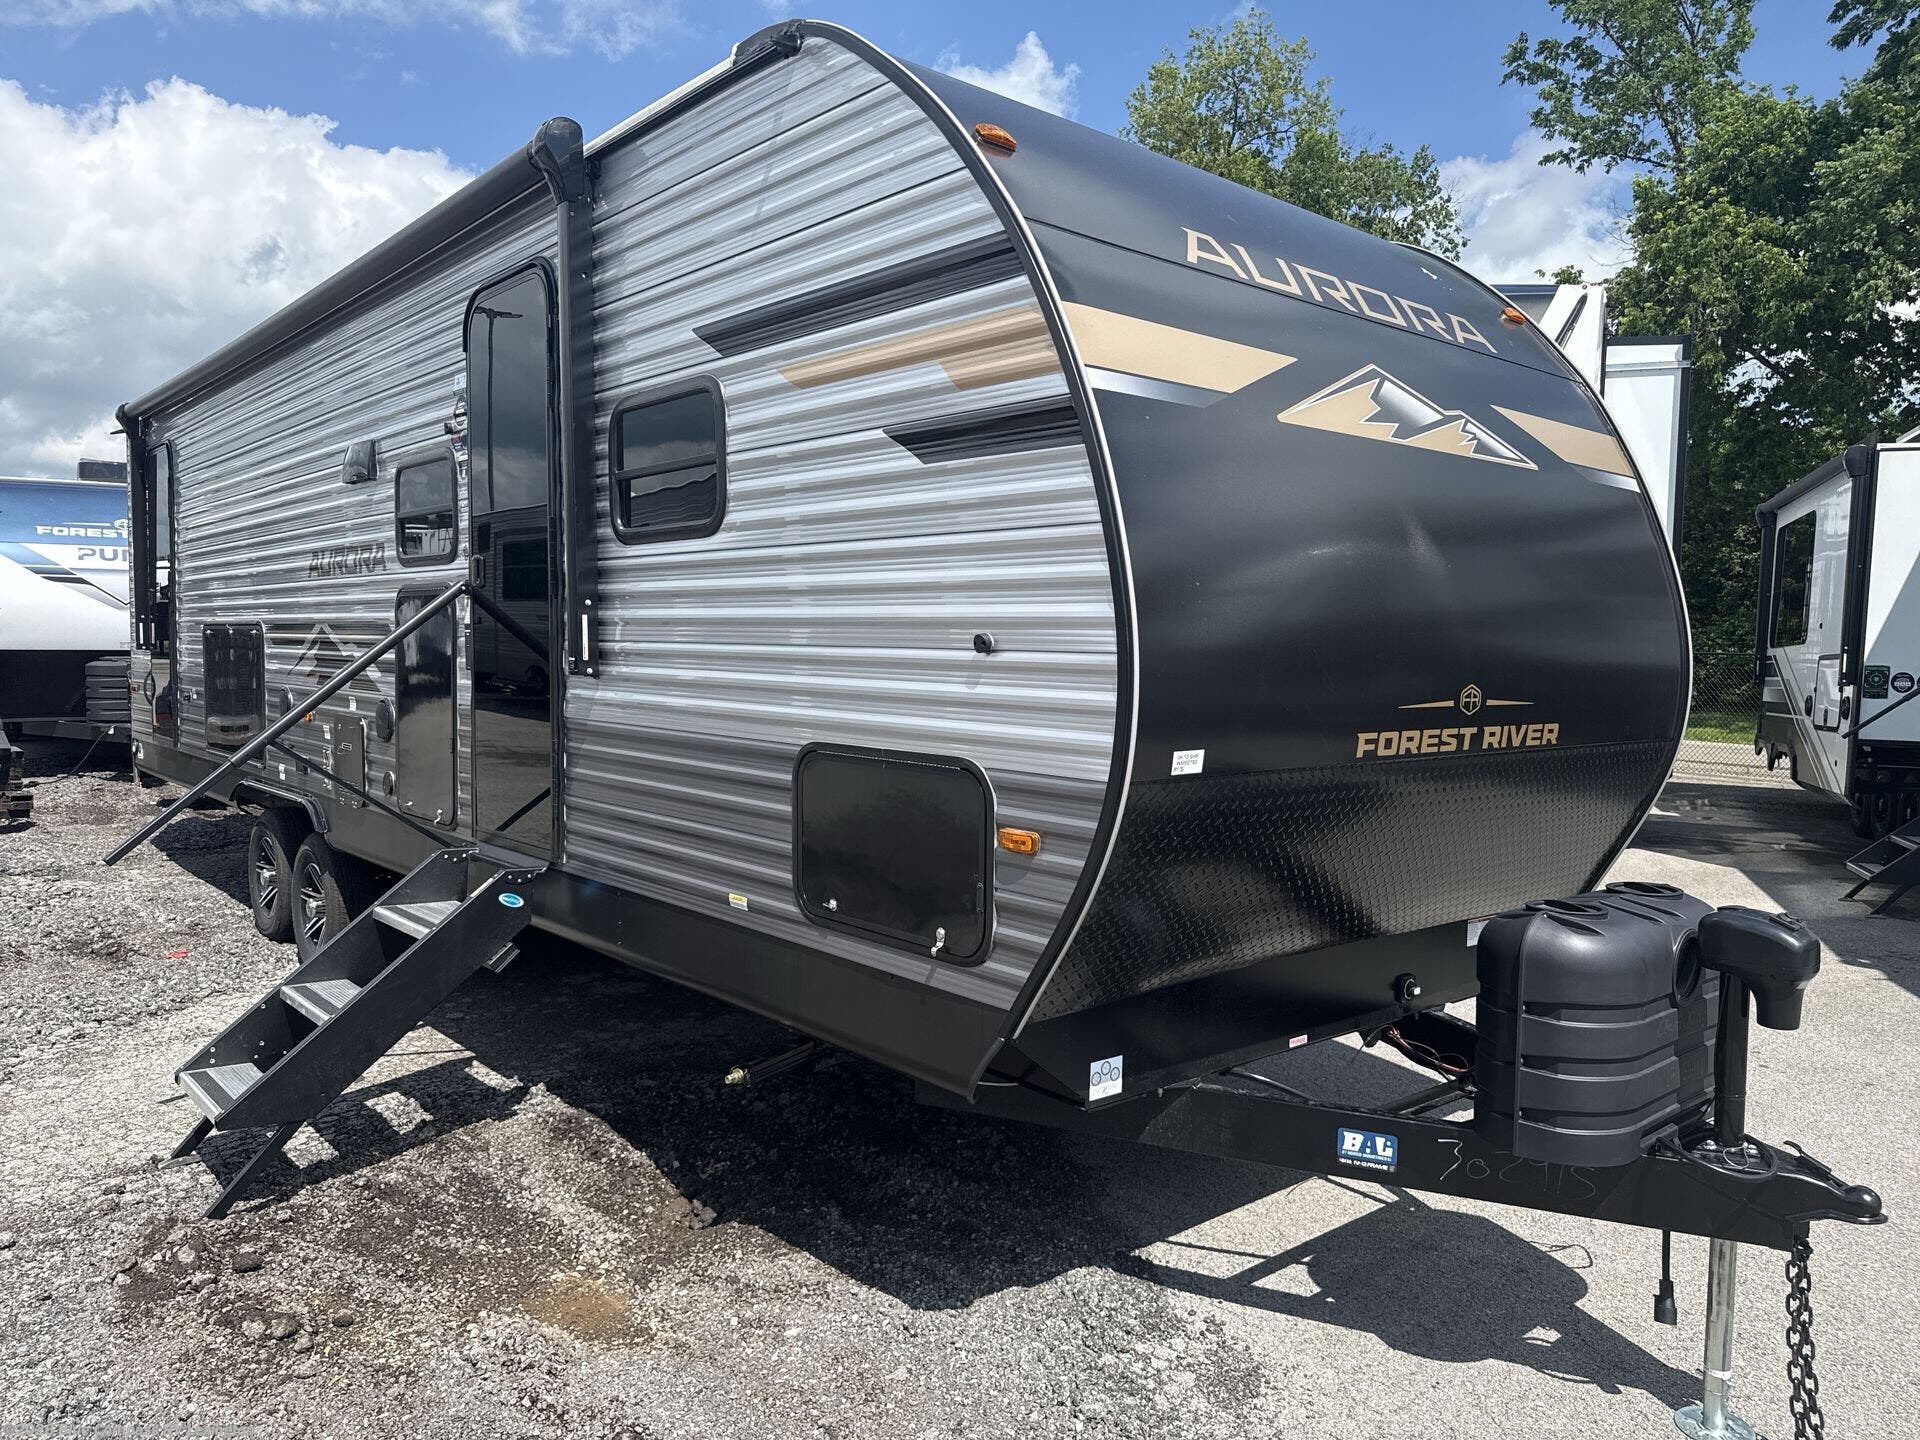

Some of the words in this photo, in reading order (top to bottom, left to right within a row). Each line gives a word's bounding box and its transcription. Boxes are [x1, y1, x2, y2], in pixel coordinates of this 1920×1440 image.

[1180, 227, 1497, 353] AURORA
[35, 526, 128, 538] FOREST
[308, 543, 386, 578] AURORA
[1356, 727, 1478, 758] FOREST
[1482, 723, 1560, 750] RIVER
